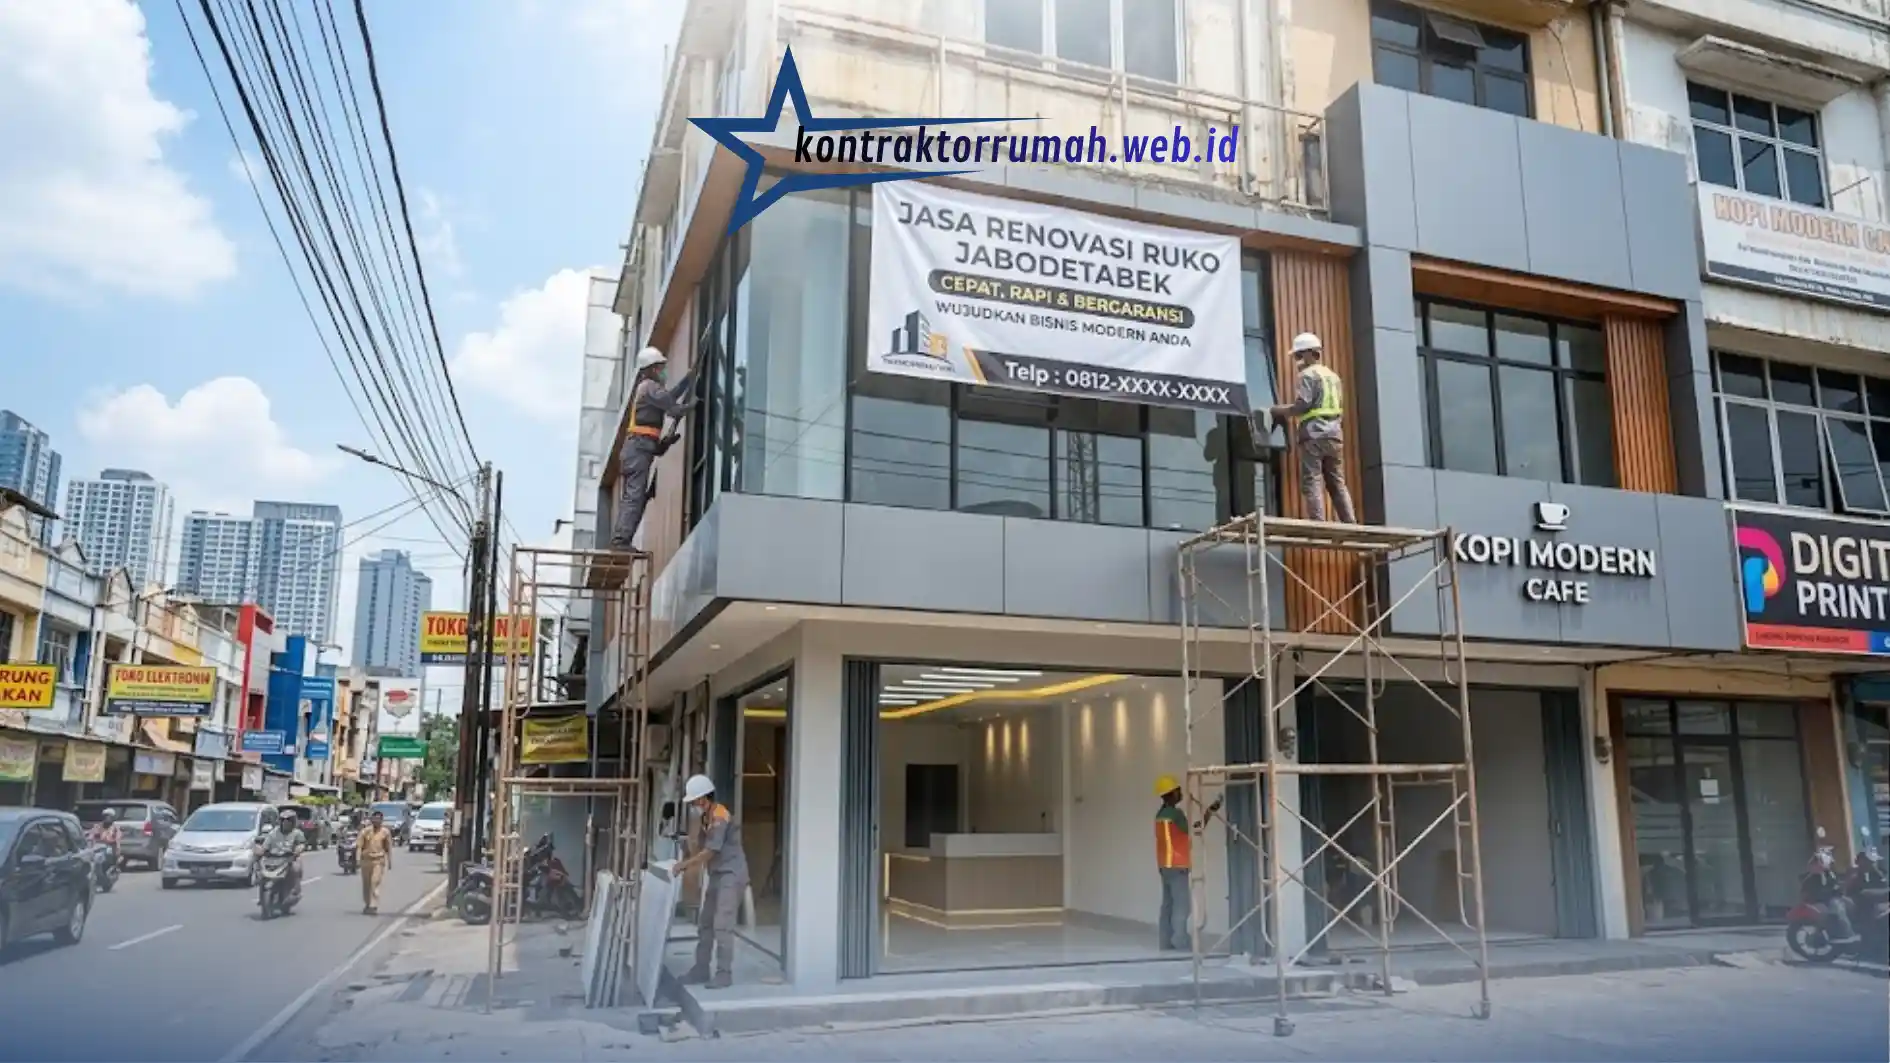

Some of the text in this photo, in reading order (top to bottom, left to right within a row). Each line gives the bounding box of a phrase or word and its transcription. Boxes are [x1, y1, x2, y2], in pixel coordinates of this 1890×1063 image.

[898, 200, 1221, 274] JASA RENOVASI RUKO
[954, 240, 1173, 296] JABODETABEK
[1010, 283, 1053, 304] RAPI
[1056, 291, 1069, 308] &
[935, 299, 1192, 348] WUJUDKAN BISNIS MODERN ANDA
[1004, 360, 1049, 387] Telp
[1065, 368, 1231, 405] 0812-XXXX-XXXX
[1453, 532, 1656, 577] KOPI MODERN
[1526, 577, 1592, 604] CAFE
